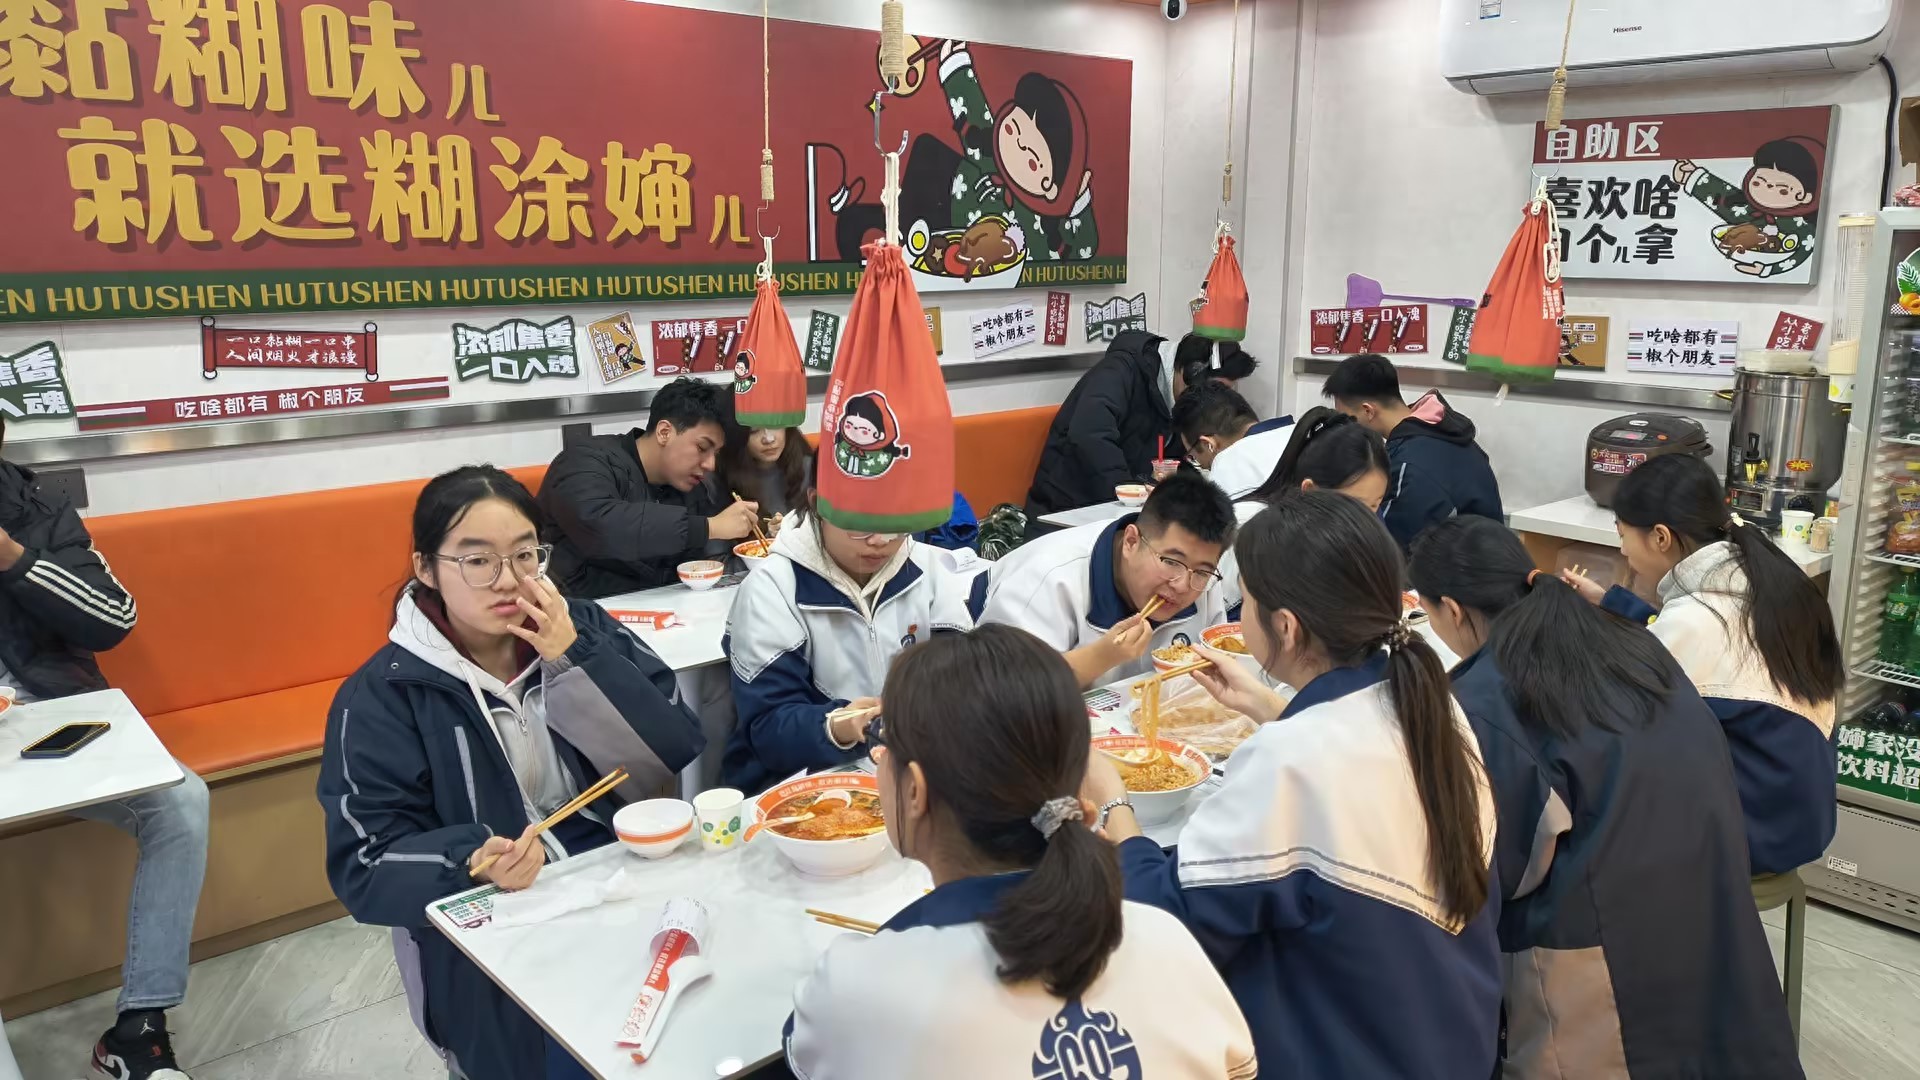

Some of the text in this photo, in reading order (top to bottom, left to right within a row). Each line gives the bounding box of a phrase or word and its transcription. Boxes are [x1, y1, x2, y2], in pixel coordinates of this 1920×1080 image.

[1613, 25, 1643, 34] Hisense
[1545, 121, 1664, 160] 自助区
[57, 116, 751, 245] 就选糊涂婶儿
[1547, 175, 1681, 220] 喜欢啥
[46, 284, 251, 313] HUTUSHEN
[260, 280, 432, 307] HUTUSHEN
[440, 277, 588, 301] HUTUSHEN
[597, 274, 723, 297] HUTUSHEN
[728, 270, 839, 293] HUUSHEN
[1036, 265, 1112, 282] HUTUSHEN
[983, 307, 1024, 330] 吃啥都有
[1315, 309, 1364, 325] 浓郁焦香
[457, 318, 574, 357] 浓郁焦香
[658, 319, 717, 339] 浓郁焦香
[985, 327, 1026, 348] 椒个朋友
[1646, 328, 1717, 346] 吃啥都有
[226, 332, 357, 350] 一口黏糊一口串
[225, 349, 359, 366] 人间烟火才浪漫
[461, 354, 576, 380] 一口入魂
[1645, 348, 1717, 366] 椒个朋友
[174, 386, 365, 418] 吃啥都有 椒个朋友
